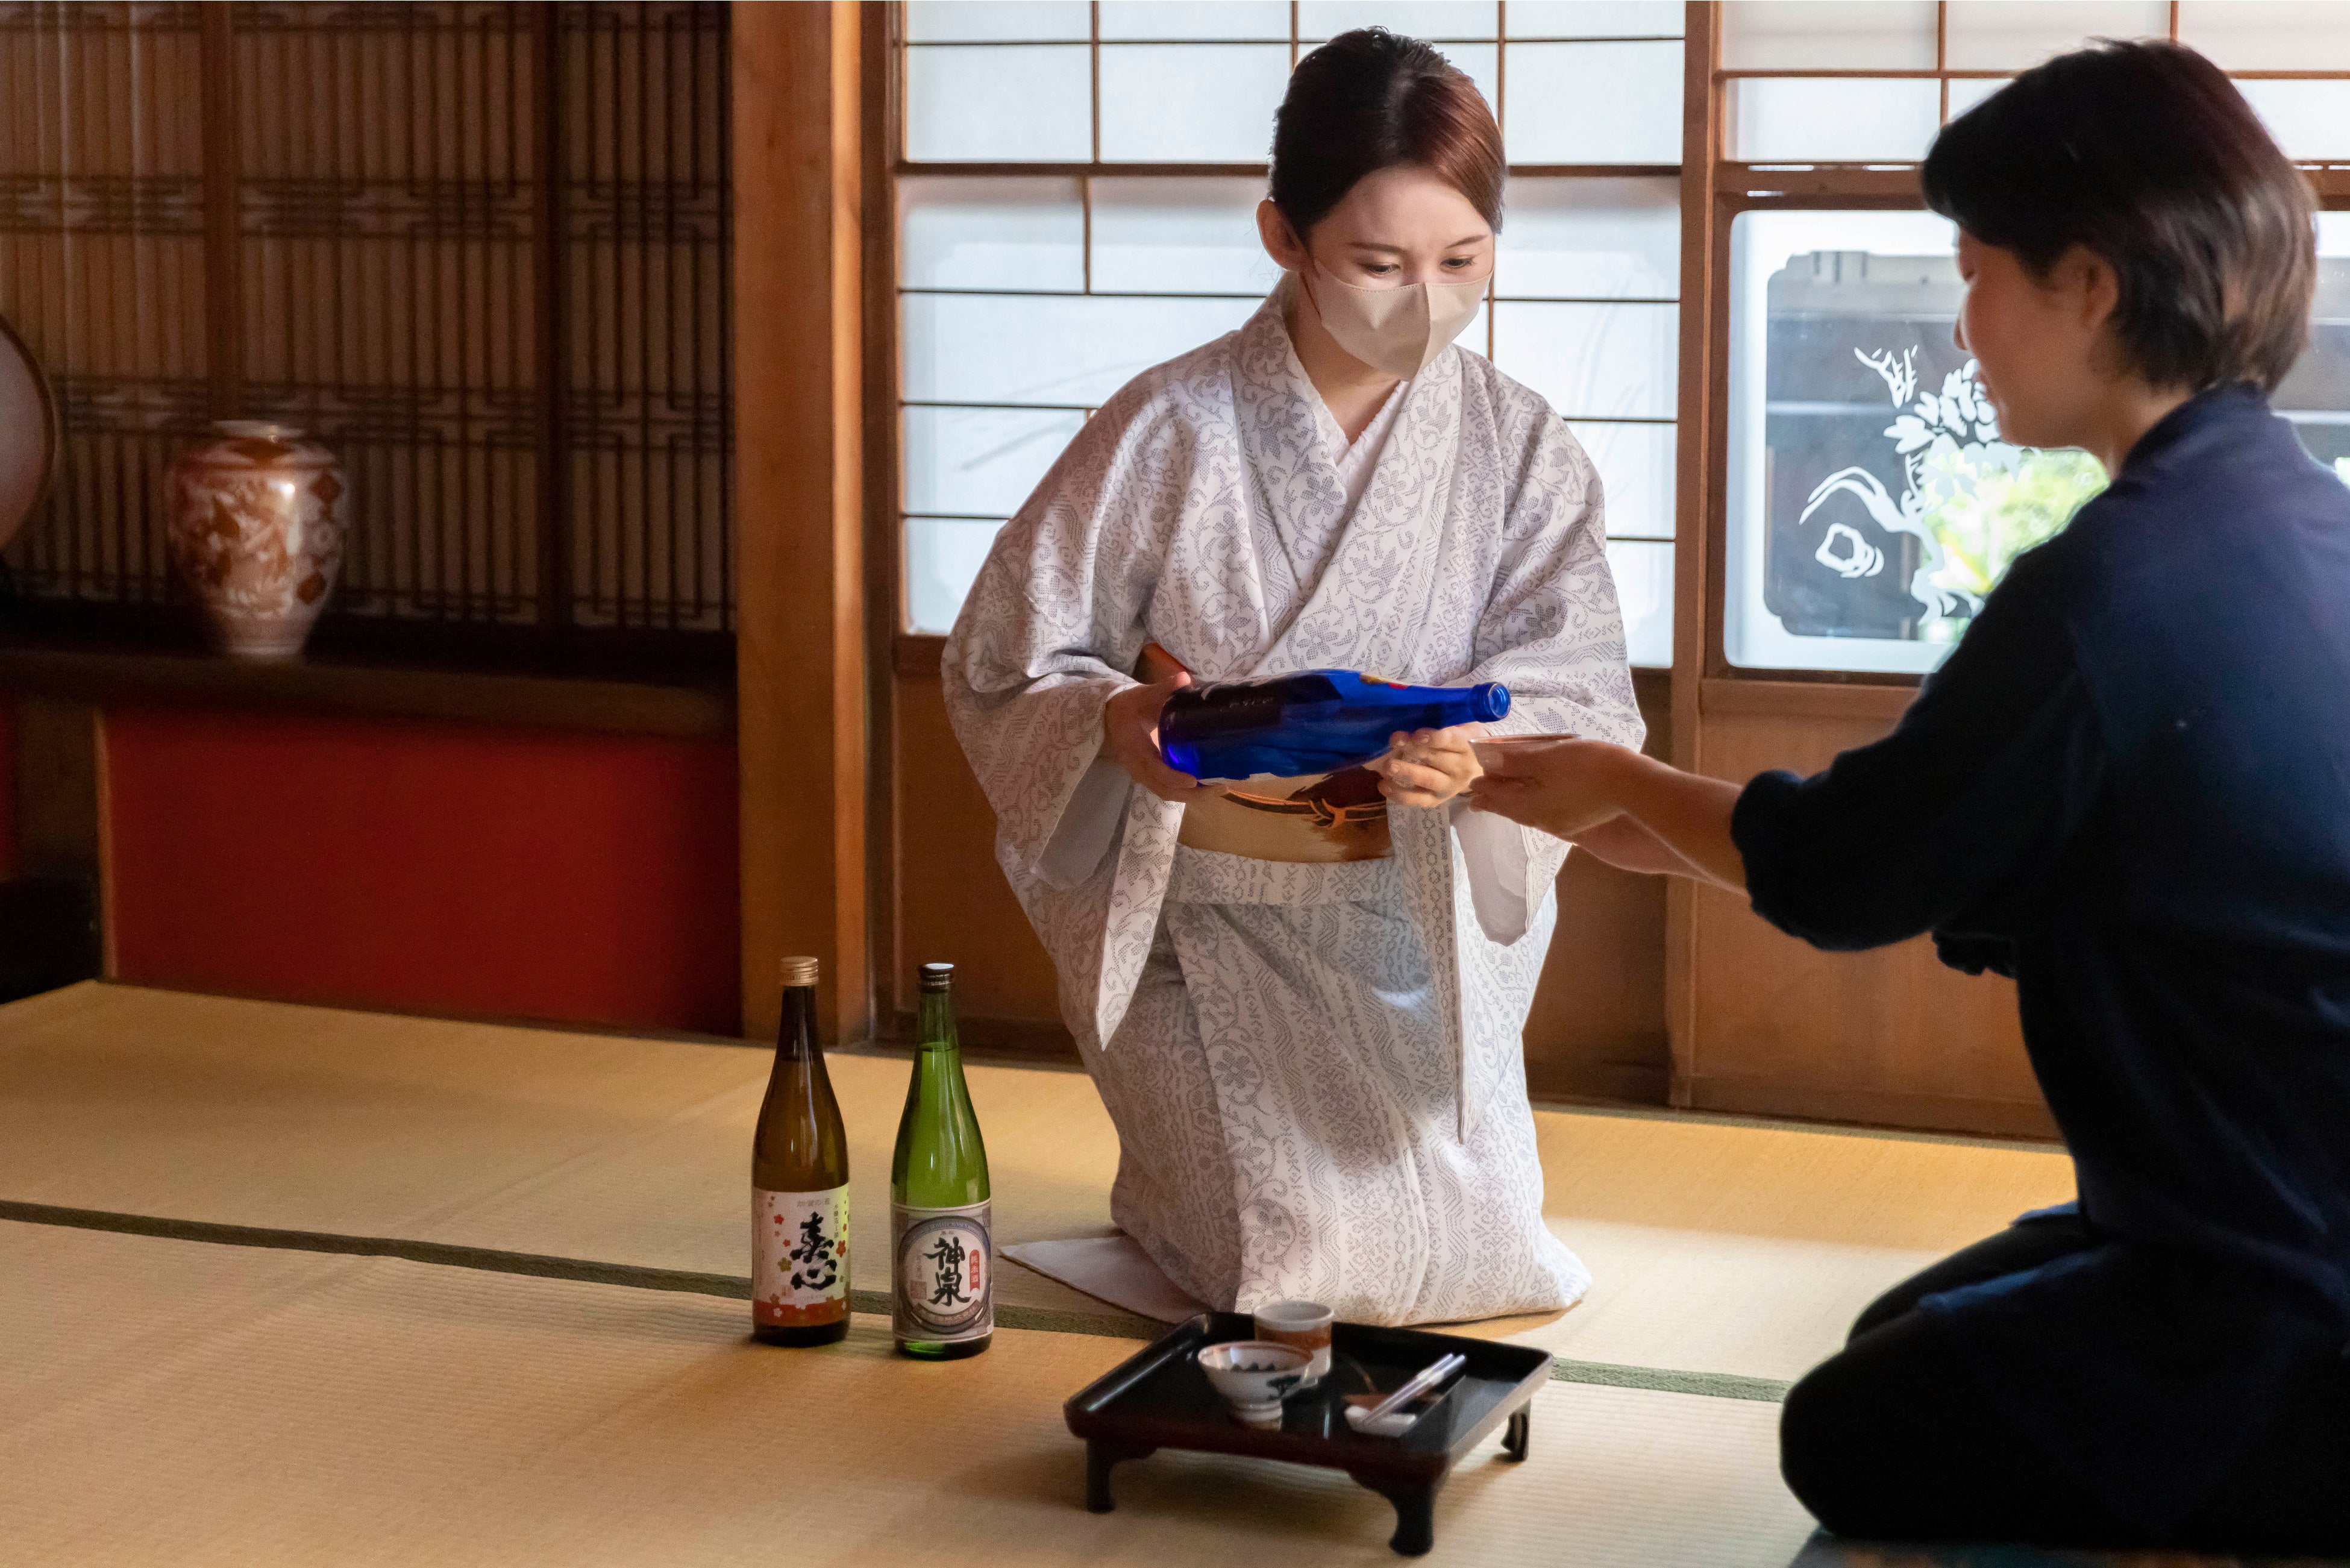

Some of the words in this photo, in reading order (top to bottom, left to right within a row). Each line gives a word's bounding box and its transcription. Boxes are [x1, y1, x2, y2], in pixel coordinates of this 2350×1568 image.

[923, 1236, 972, 1306] 神泉
[971, 1254, 979, 1283] 純米酒
